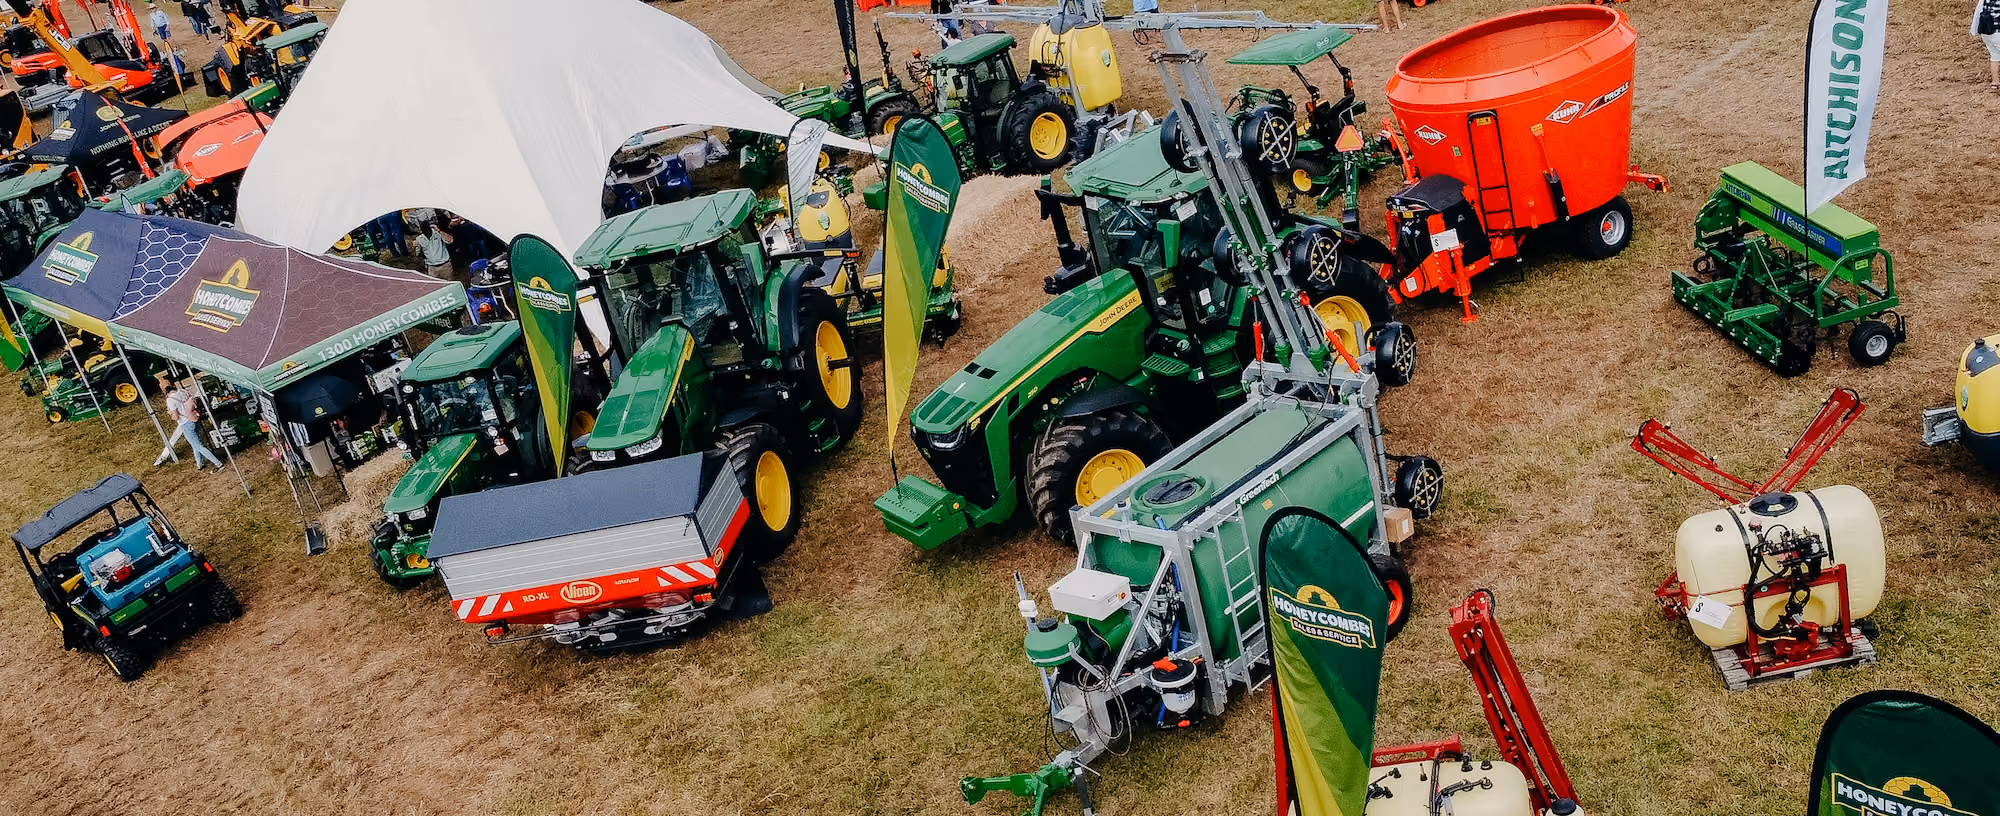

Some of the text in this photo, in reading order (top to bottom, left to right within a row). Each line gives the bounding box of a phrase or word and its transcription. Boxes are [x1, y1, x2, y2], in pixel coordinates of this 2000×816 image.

[48, 29, 71, 52] JCB
[1824, 0, 1867, 179] AITCHISON
[1553, 103, 1580, 120] KUHN
[90, 139, 119, 155] NOTHING
[118, 133, 134, 144] RUN
[134, 128, 148, 138] LIKE
[1418, 130, 1441, 141] KUHN
[195, 289, 255, 315] HONEYCOMBES
[520, 285, 568, 306] HONEYCOMBES
[1099, 296, 1137, 327] JOHN DEERE
[317, 292, 456, 362] 1300 HONEYCOMBES
[1239, 472, 1280, 505] GreenTech
[564, 581, 596, 599] Vicon
[1273, 595, 1371, 638] HONEYCOMBES
[1837, 781, 1952, 816] HONEYCO
